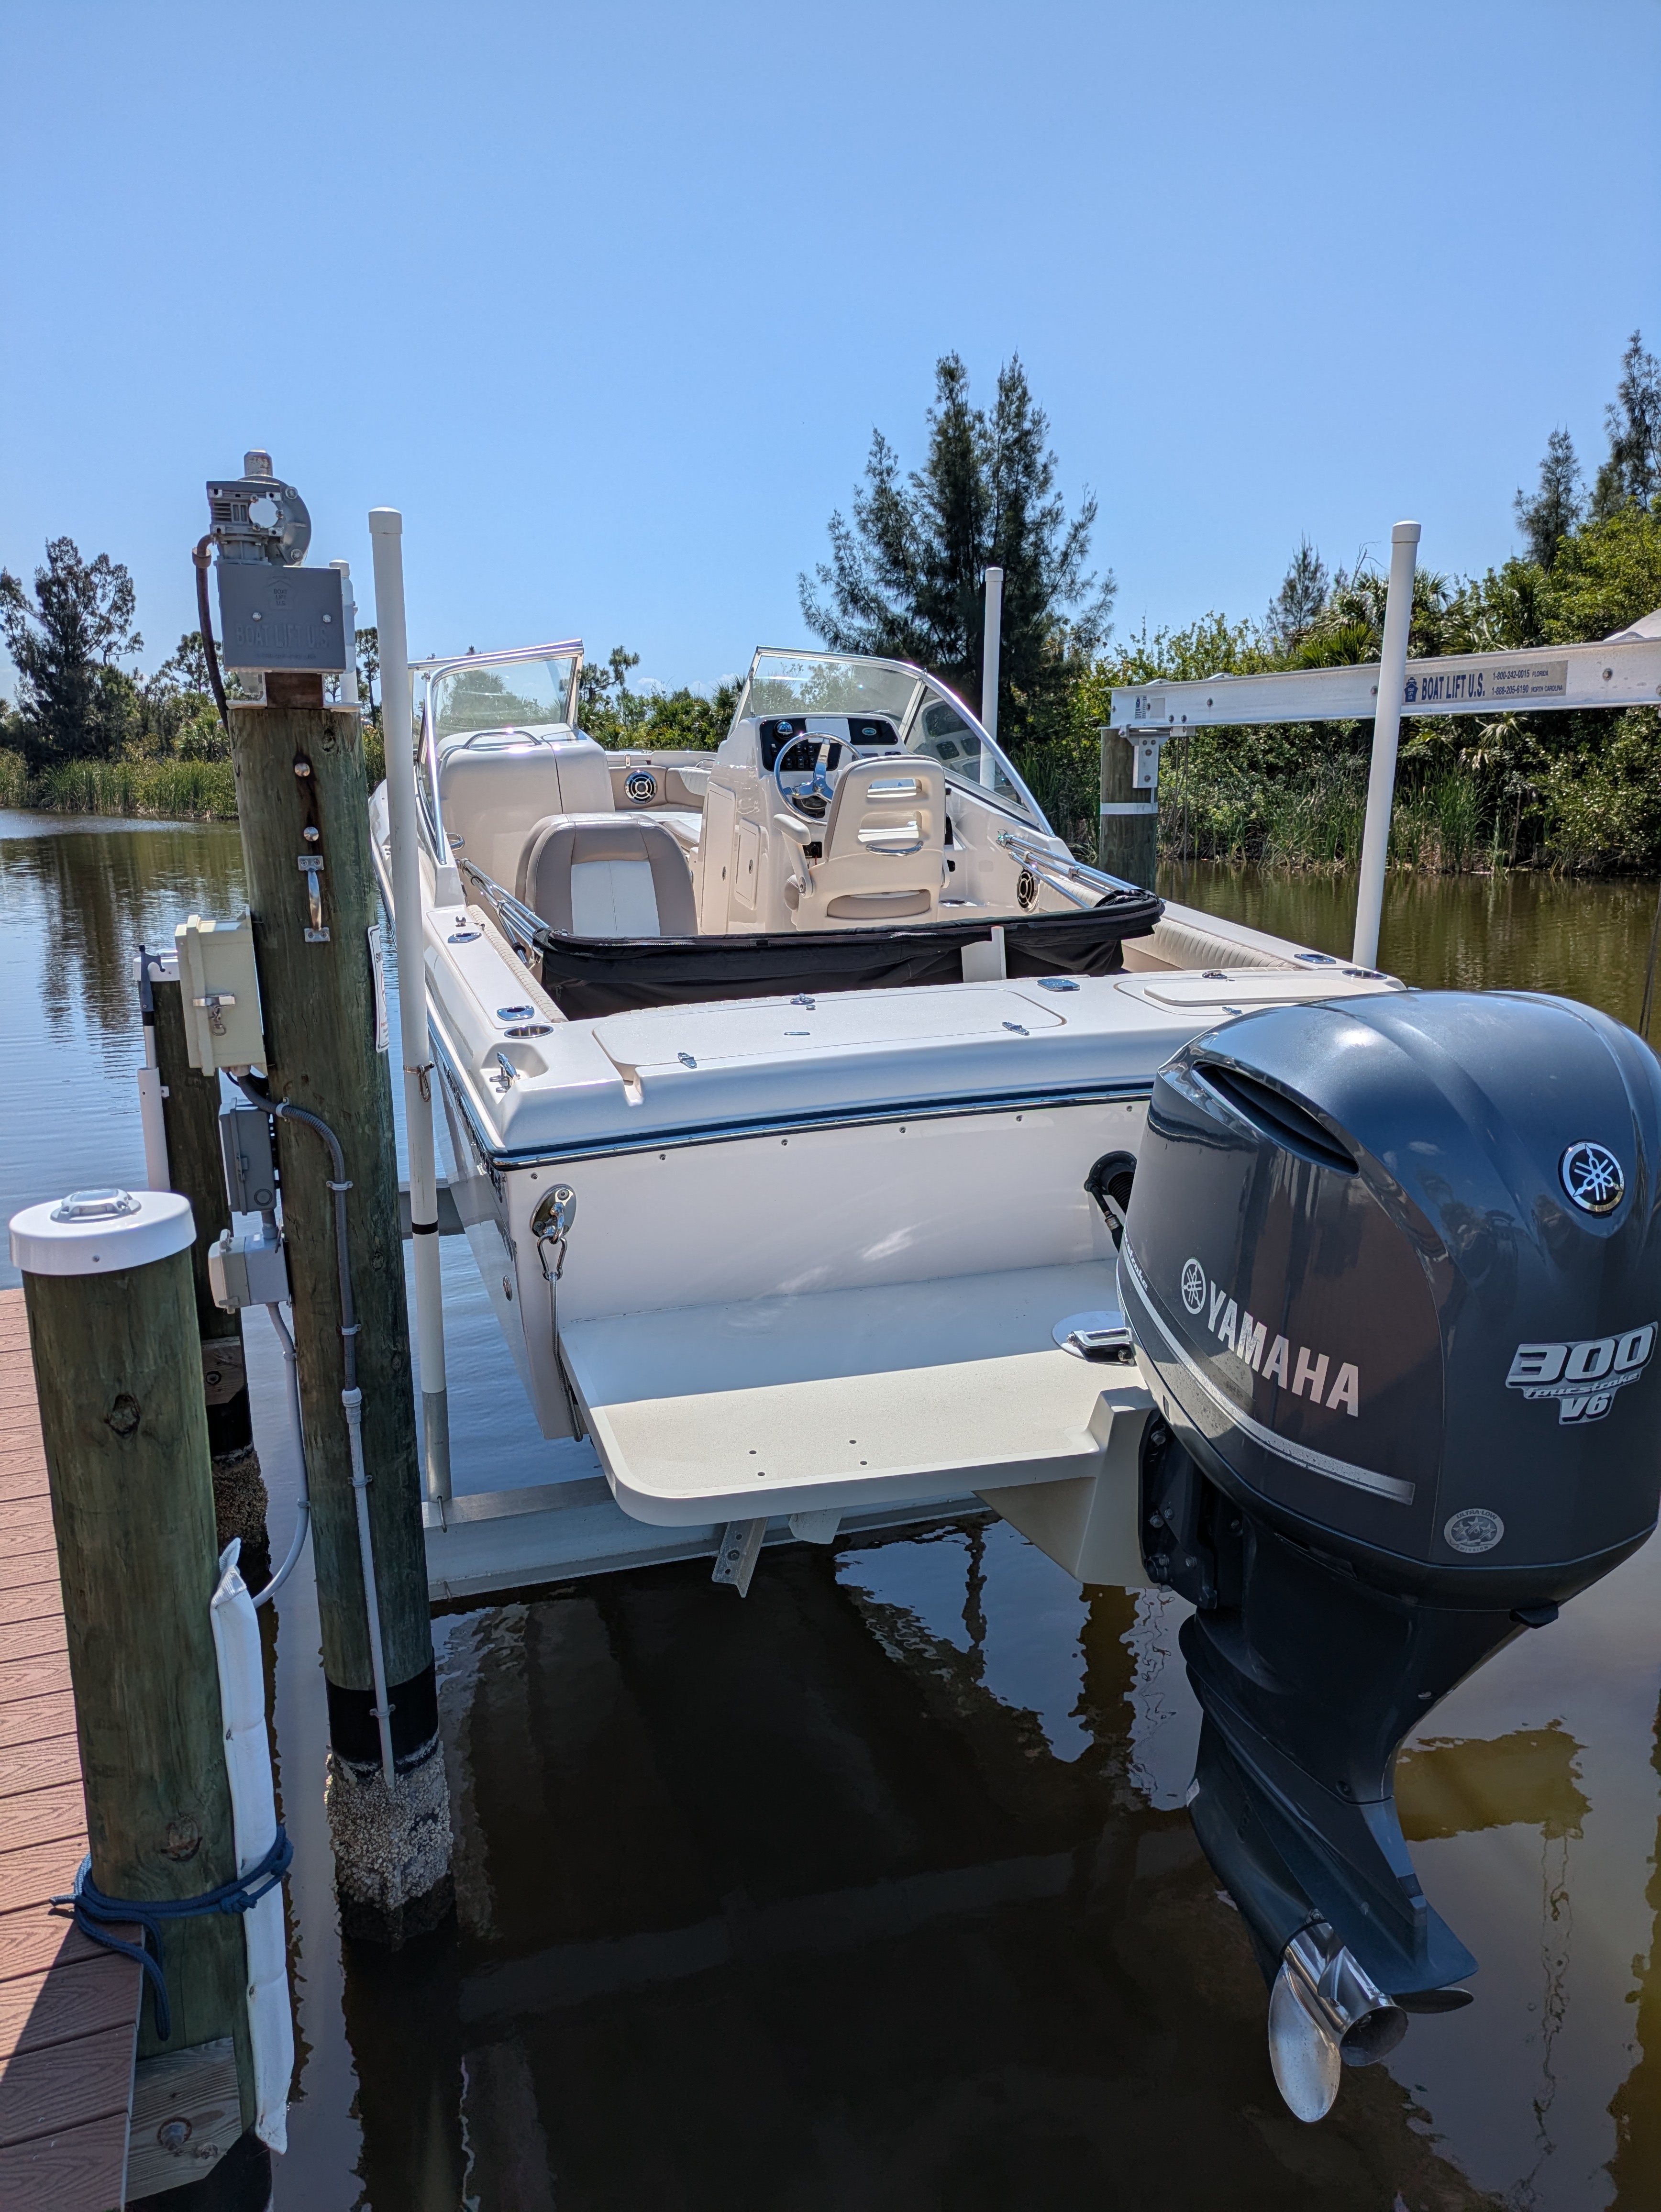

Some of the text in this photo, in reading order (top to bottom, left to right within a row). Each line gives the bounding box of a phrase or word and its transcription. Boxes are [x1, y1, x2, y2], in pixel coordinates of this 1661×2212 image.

[236, 623, 330, 649] BOAT LIFT U.S.
[1421, 672, 1485, 700] BOAT LIFT U.S.
[1493, 669, 1530, 680] 1-800-242-0015
[1492, 685, 1529, 696] 1-888-205-6190
[1207, 1280, 1359, 1417] YAMAHA
[1507, 1326, 1655, 1385] 300
[1561, 1393, 1612, 1421] V6
